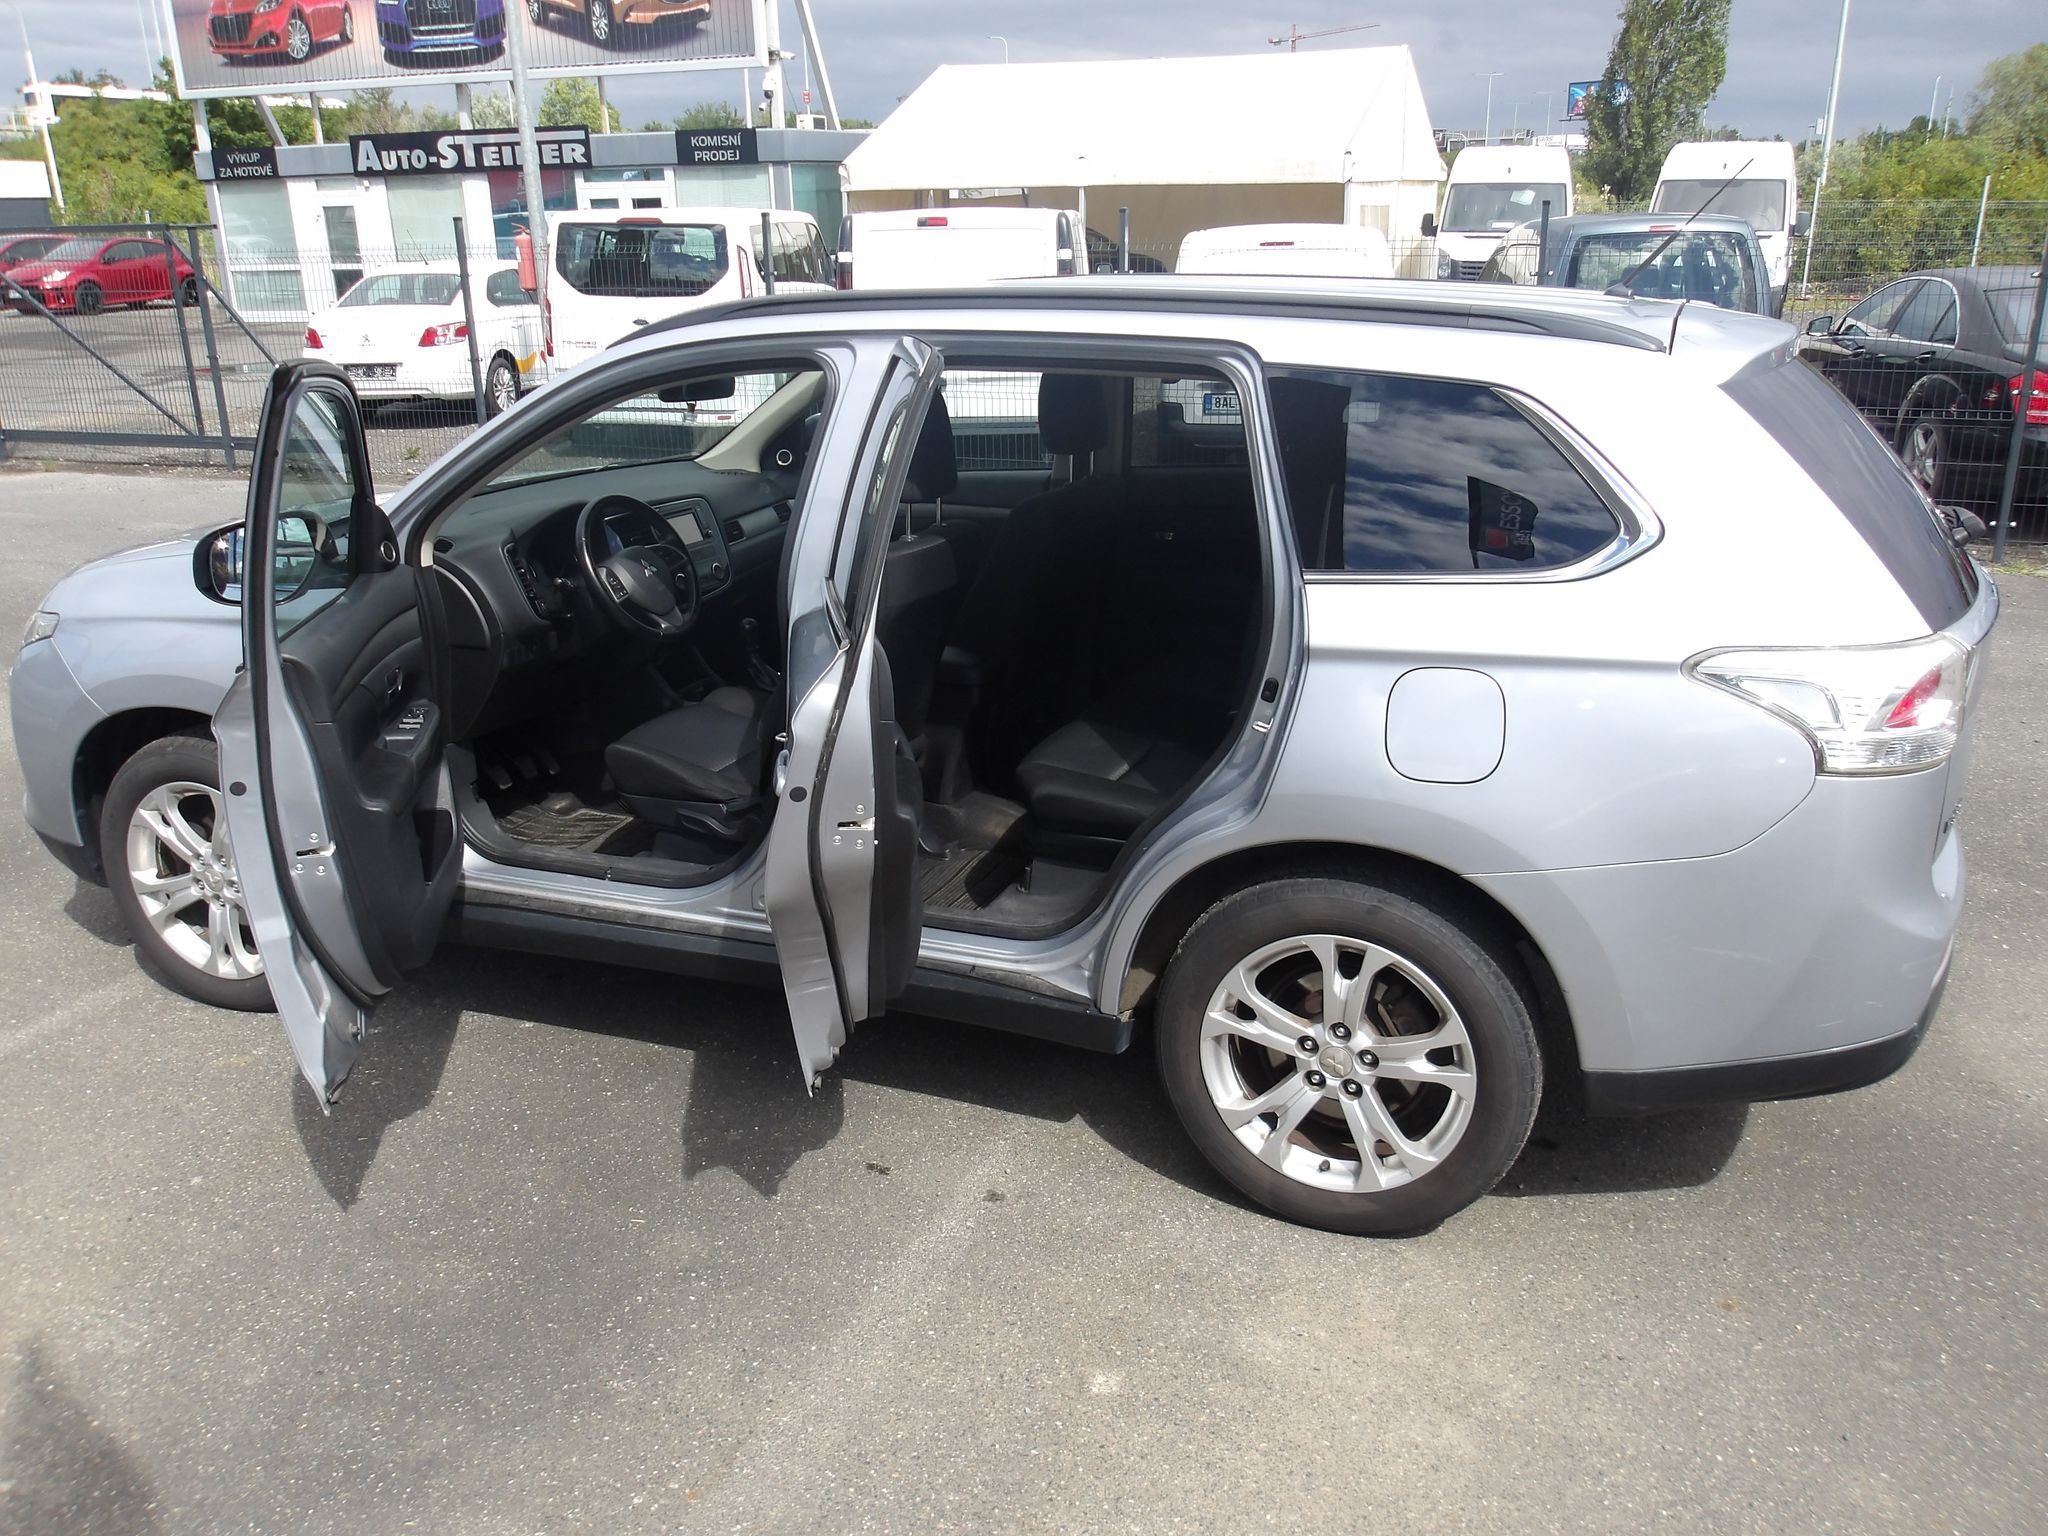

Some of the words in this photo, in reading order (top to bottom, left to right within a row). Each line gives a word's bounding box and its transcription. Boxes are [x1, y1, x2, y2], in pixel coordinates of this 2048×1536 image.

[691, 132, 742, 147] KOMISNÍ
[227, 152, 261, 164] VÝKUP
[357, 130, 588, 172] AUTO-STEIER
[694, 150, 740, 162] PRODEJ
[219, 167, 234, 178] ZA
[234, 163, 274, 177] HOTOVÉ
